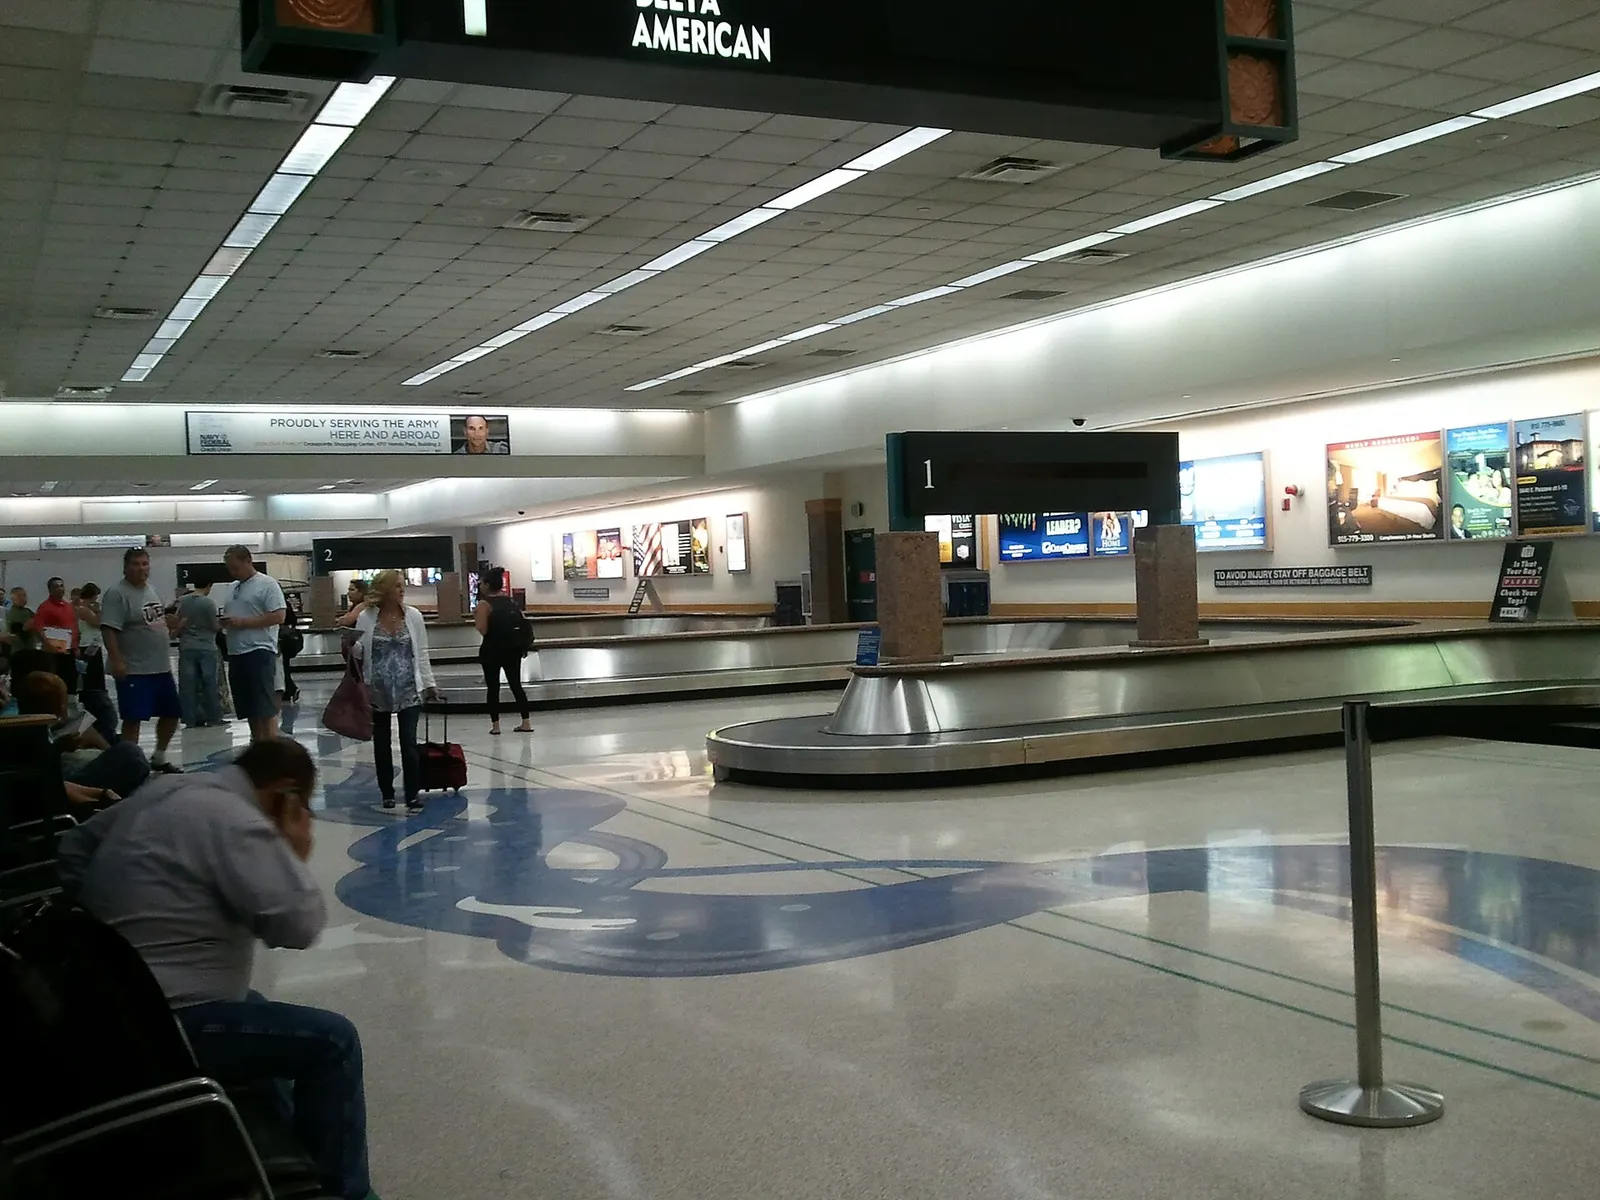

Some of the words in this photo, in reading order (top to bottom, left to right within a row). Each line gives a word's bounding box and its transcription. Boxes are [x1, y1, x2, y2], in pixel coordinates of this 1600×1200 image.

[631, 12, 771, 62] AMERICAN
[270, 418, 327, 428] PROUDLY
[330, 419, 380, 428] SERVING
[383, 419, 404, 428] THE
[407, 419, 439, 428] ARMY
[330, 430, 361, 439] HERE
[363, 430, 389, 440] AND
[391, 430, 440, 440] ABROAD
[923, 459, 935, 489] 1
[324, 548, 333, 562] 2
[182, 570, 189, 579] 3
[1215, 571, 1226, 580] TO
[1226, 570, 1247, 580] AVOID
[1247, 570, 1273, 579] INJURY
[1273, 569, 1292, 579] STAY
[1292, 569, 1308, 578] OFF
[1308, 568, 1347, 578] BAGGAGE
[1348, 567, 1369, 577] BELT
